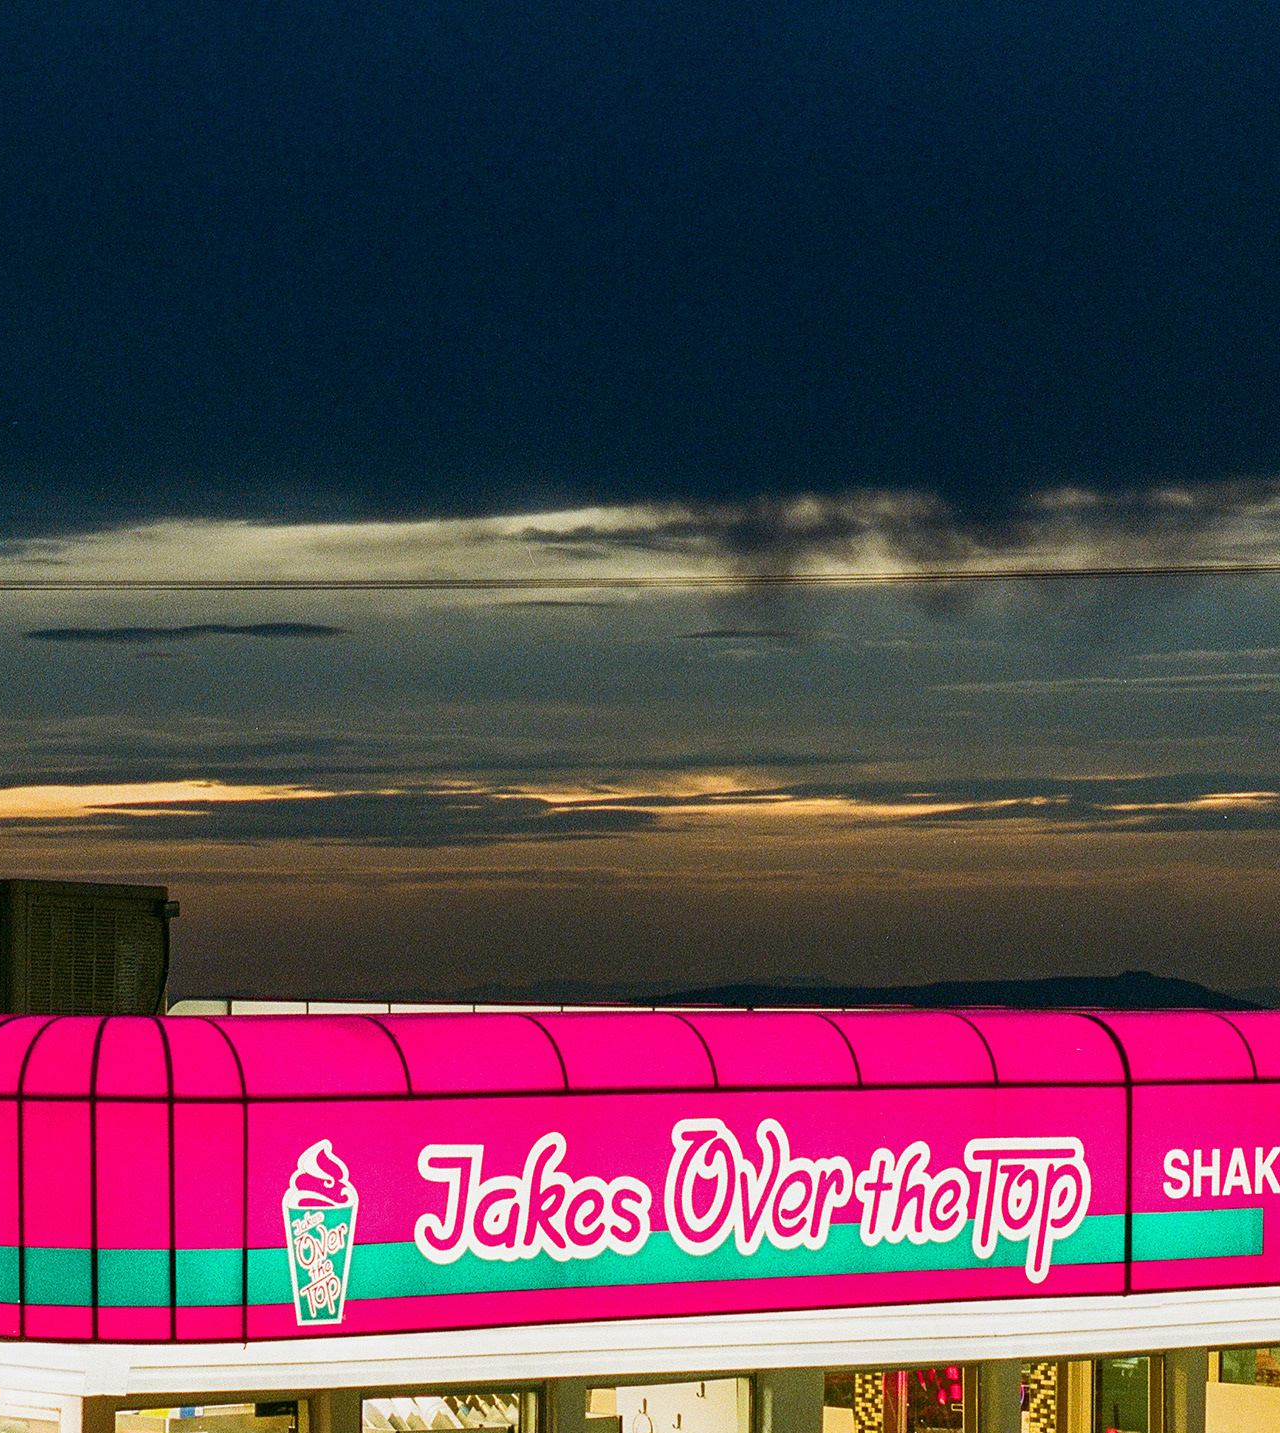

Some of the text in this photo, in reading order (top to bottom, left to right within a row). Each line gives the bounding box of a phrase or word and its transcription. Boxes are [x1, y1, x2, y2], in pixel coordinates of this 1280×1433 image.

[414, 1117, 1091, 1284] Jakes Over the Top
[292, 1211, 325, 1236] Jakes
[294, 1224, 348, 1269] Over
[308, 1259, 334, 1281] the
[299, 1270, 341, 1318] Top
